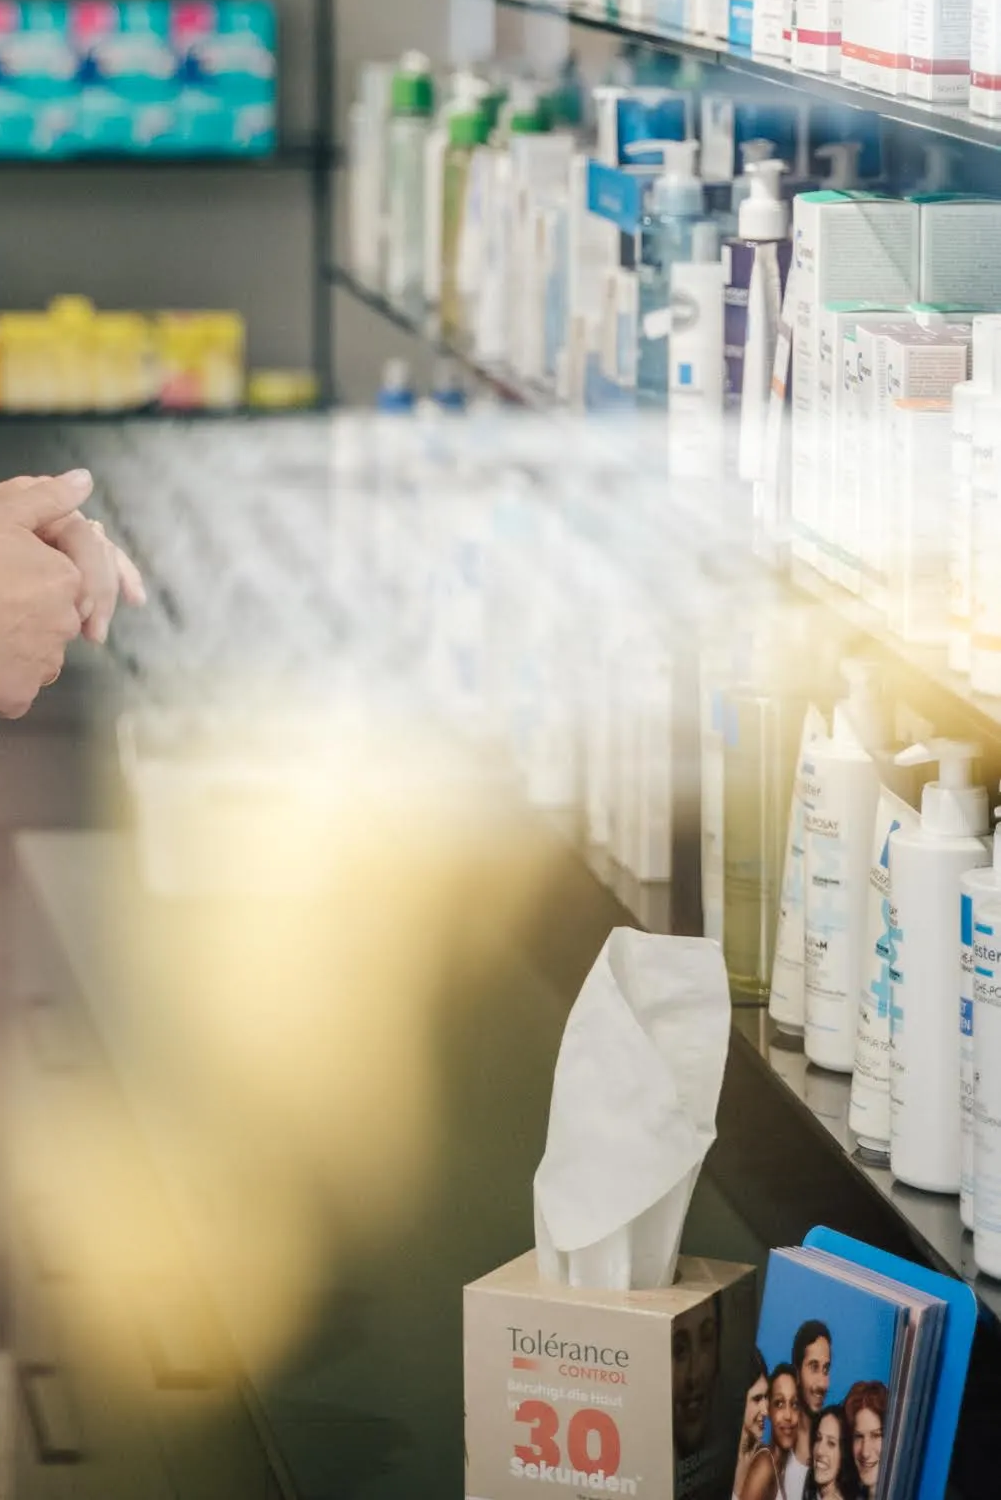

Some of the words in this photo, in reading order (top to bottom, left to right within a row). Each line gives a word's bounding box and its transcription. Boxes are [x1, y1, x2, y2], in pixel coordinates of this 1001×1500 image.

[507, 1327, 629, 1368] Tolérance
[559, 1364, 628, 1385] CONTROL
[514, 1399, 621, 1477] 30
